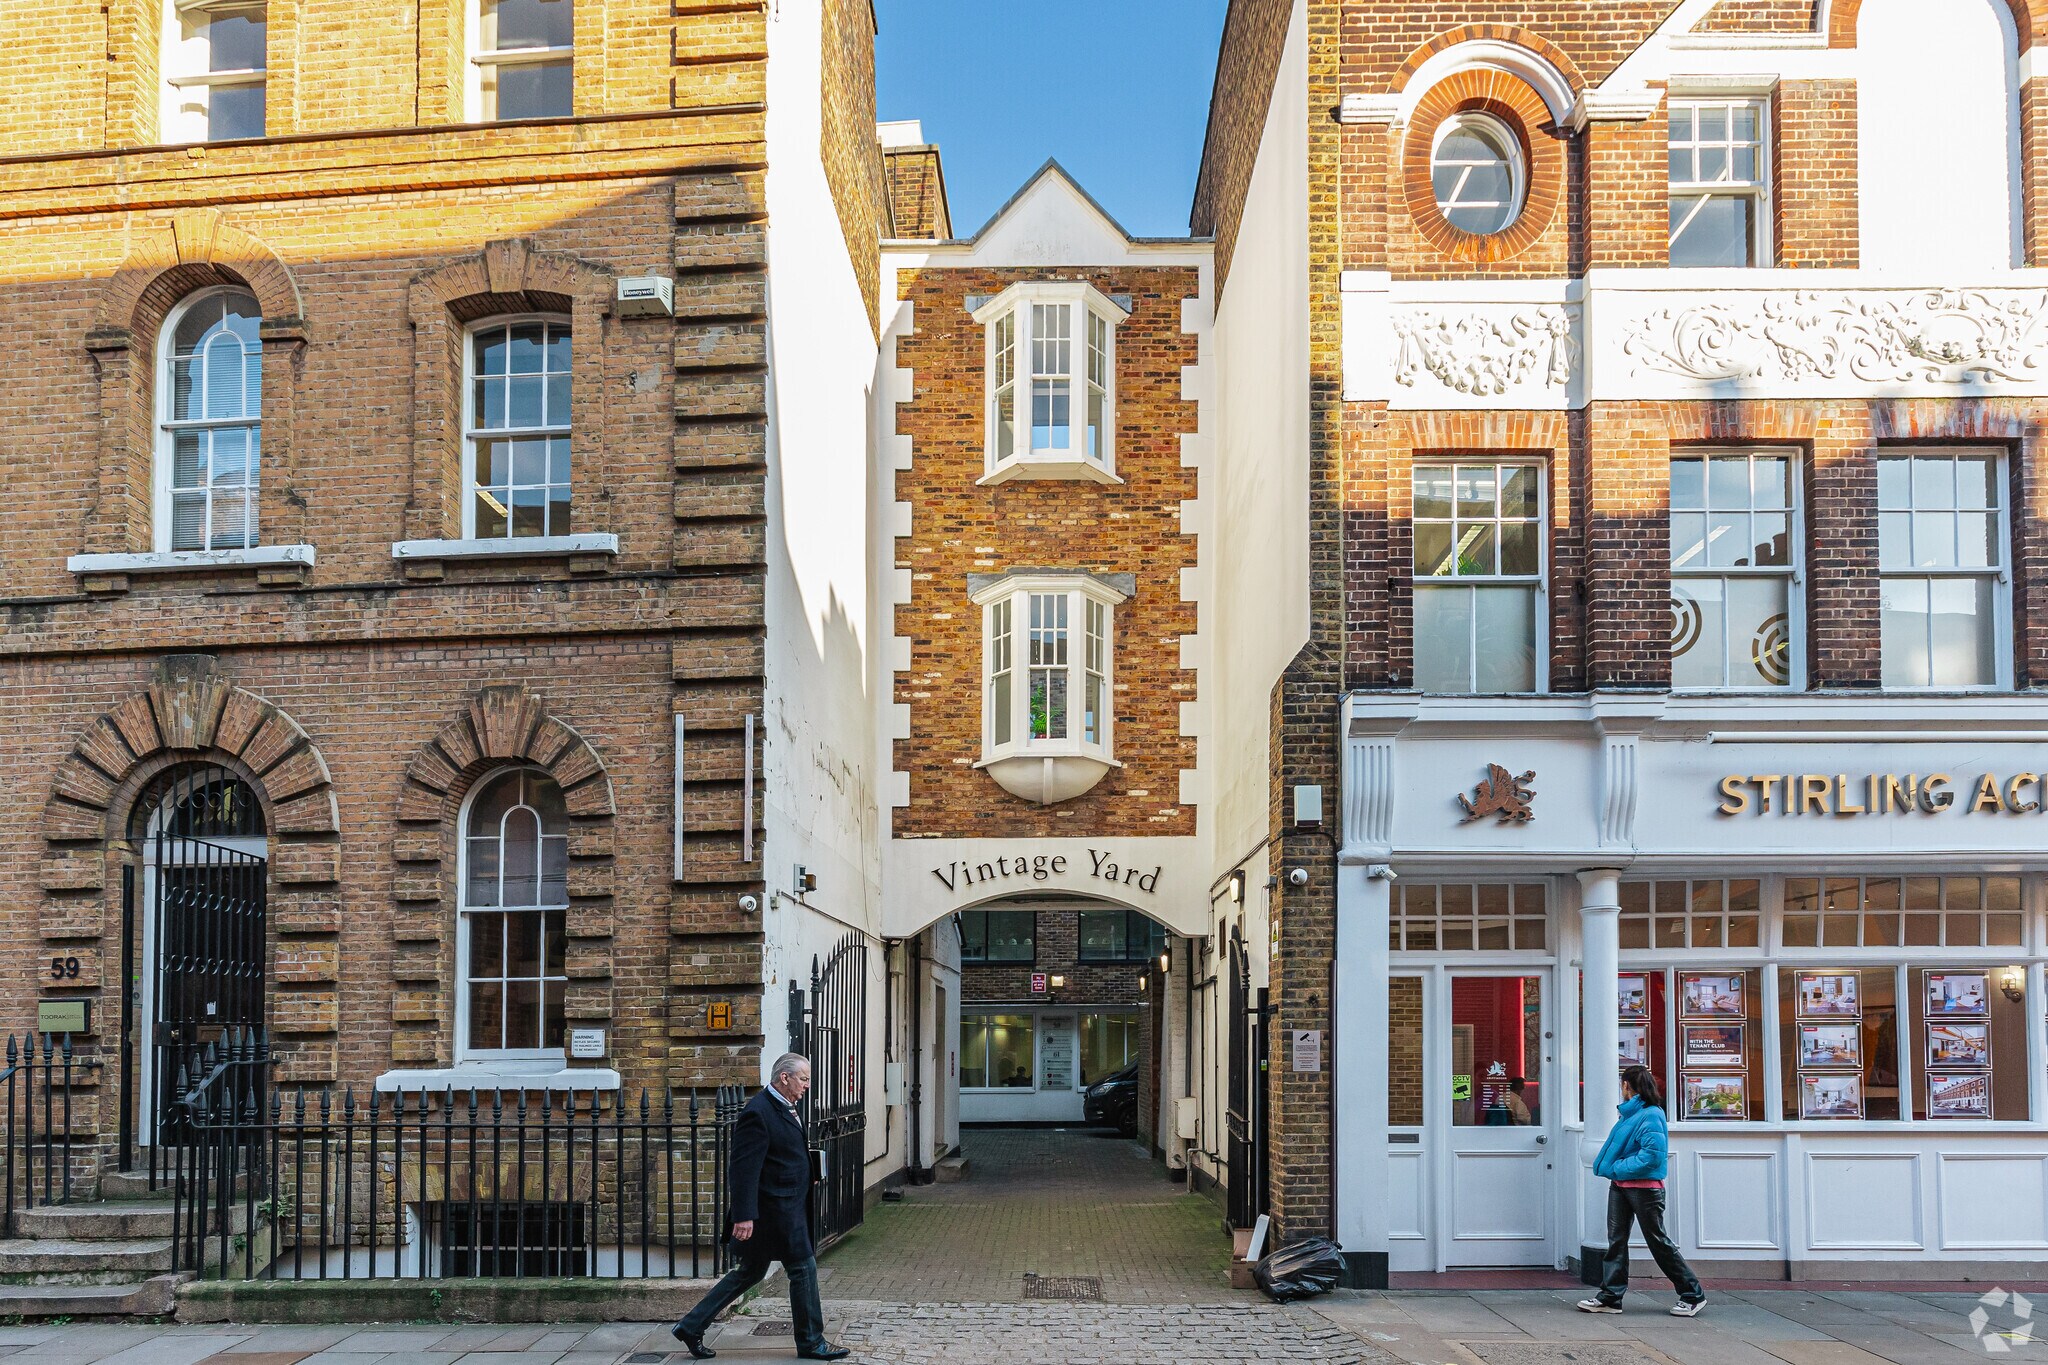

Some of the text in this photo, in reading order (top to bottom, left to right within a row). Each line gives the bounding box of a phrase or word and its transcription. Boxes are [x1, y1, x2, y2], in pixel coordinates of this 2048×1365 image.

[1718, 772, 2048, 815] STIRLING AC
[931, 848, 1162, 893] Vintage Yard
[51, 956, 80, 980] 59
